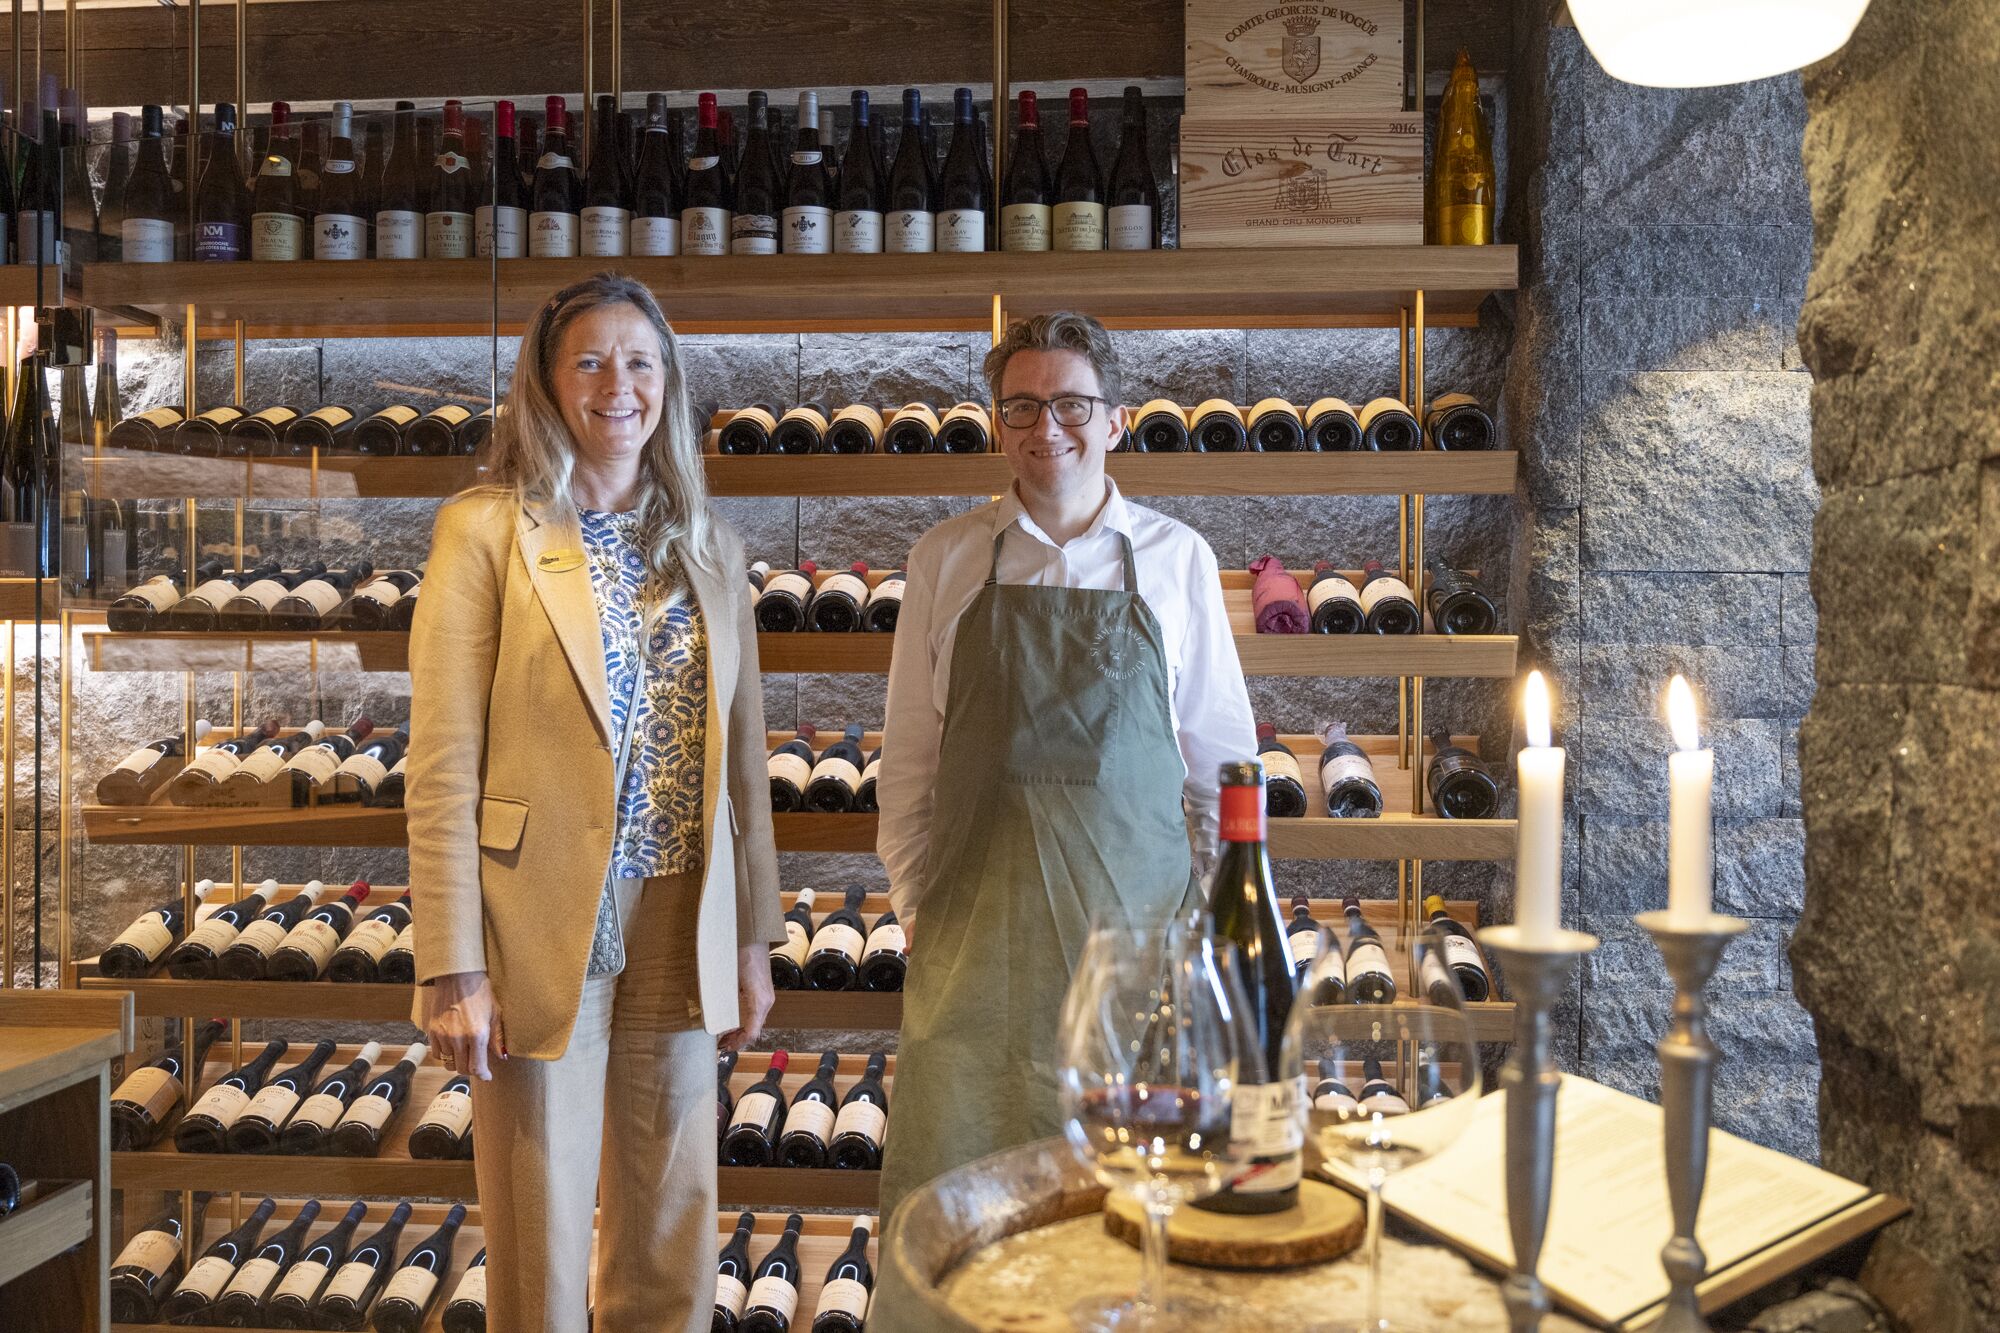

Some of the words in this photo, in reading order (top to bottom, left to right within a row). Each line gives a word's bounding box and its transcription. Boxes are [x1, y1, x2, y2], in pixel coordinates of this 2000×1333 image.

[1225, 14, 1264, 42] COMTE
[1265, 5, 1318, 20] GEORGES
[1321, 6, 1337, 18] DE
[1222, 144, 1279, 177] Clos
[1293, 138, 1313, 157] de
[1327, 133, 1383, 174] Tart
[1245, 218, 1279, 227] GRAND
[1282, 218, 1303, 226] CRU
